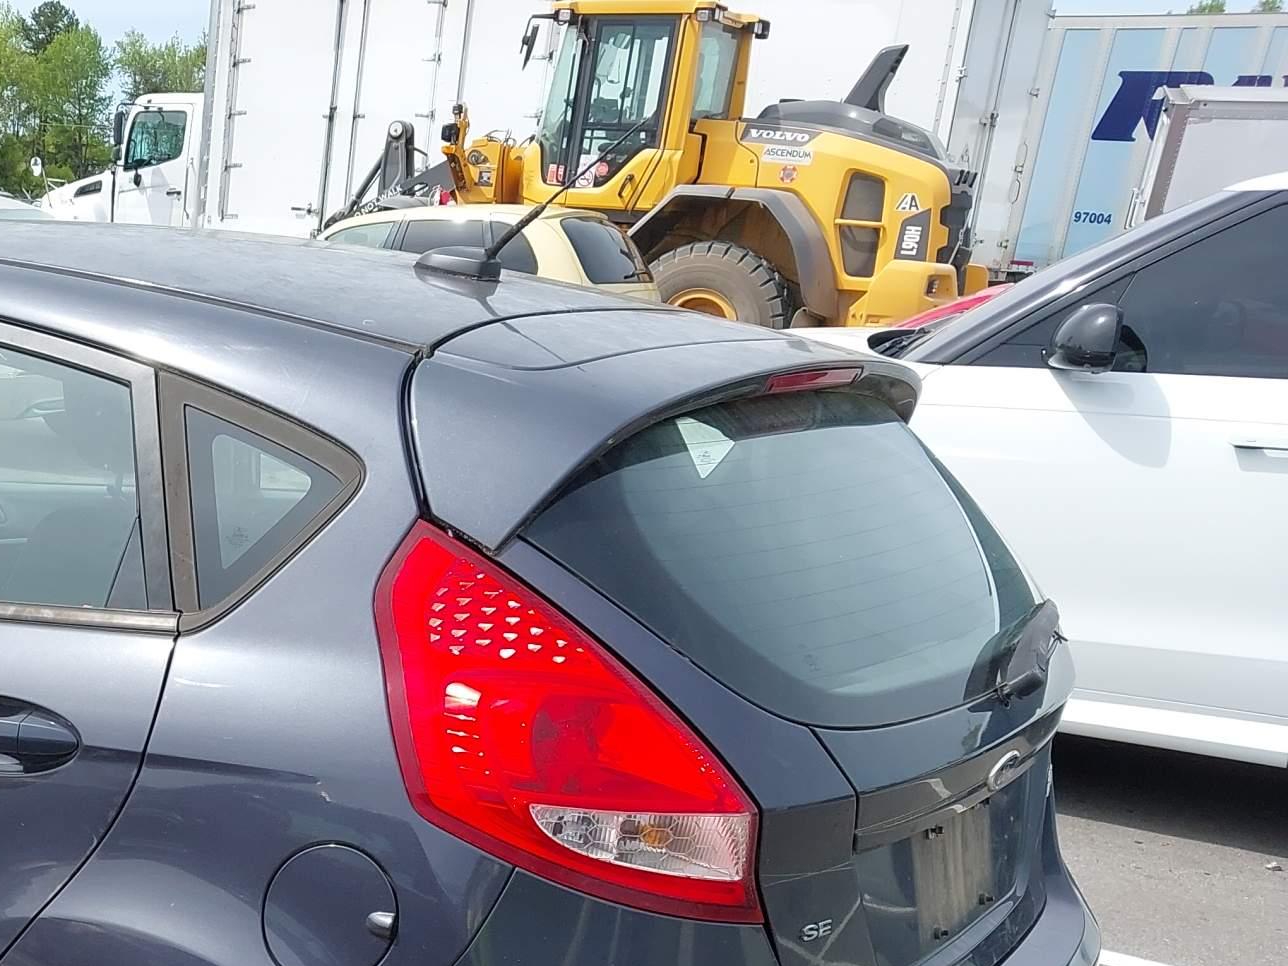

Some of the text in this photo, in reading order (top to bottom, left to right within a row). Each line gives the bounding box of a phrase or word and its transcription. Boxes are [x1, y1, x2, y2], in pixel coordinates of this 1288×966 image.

[750, 129, 810, 142] VOLVO
[764, 148, 812, 160] ASCENDUM
[379, 184, 403, 200] WALK
[1073, 211, 1112, 225] 97004
[901, 226, 922, 256] L90H
[802, 919, 833, 942] SE
